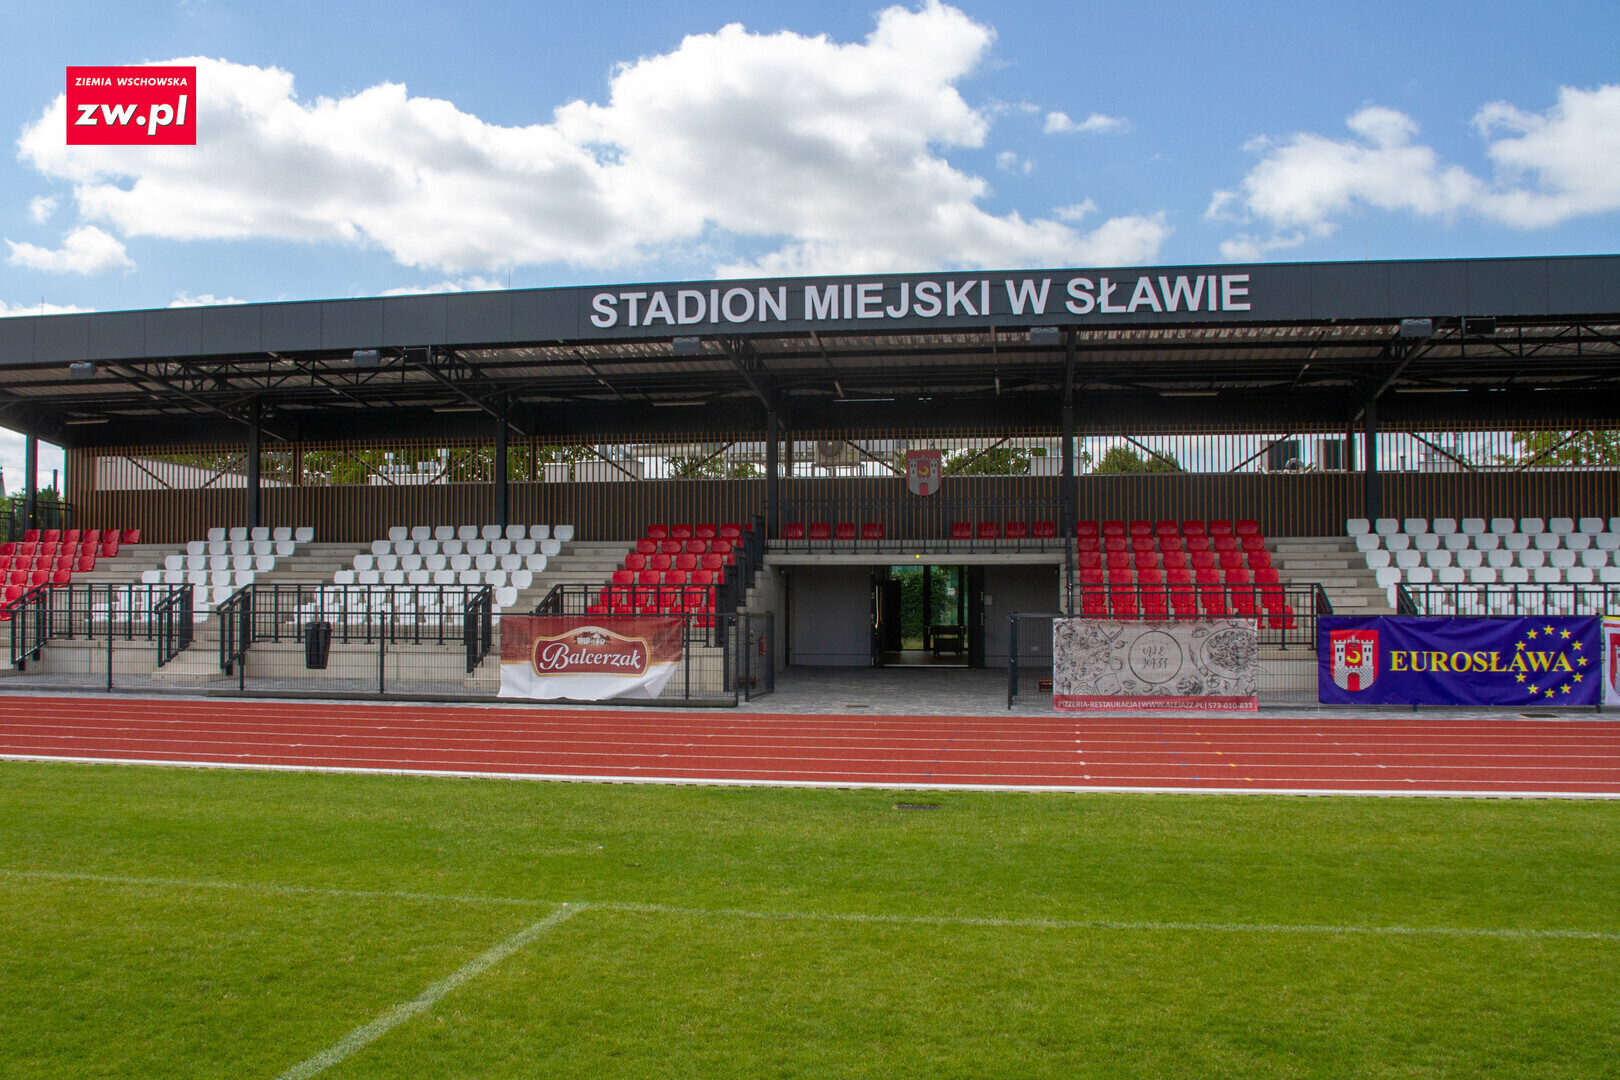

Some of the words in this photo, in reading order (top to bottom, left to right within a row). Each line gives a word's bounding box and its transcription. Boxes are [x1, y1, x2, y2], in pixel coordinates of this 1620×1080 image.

[590, 286, 787, 328] STADION
[805, 279, 990, 320] MIEJSKI
[1005, 278, 1051, 315] W
[1065, 273, 1251, 315] SŁAWIE
[540, 642, 641, 670] Balcerzak
[1389, 651, 1574, 672] EUROSŁAWA
